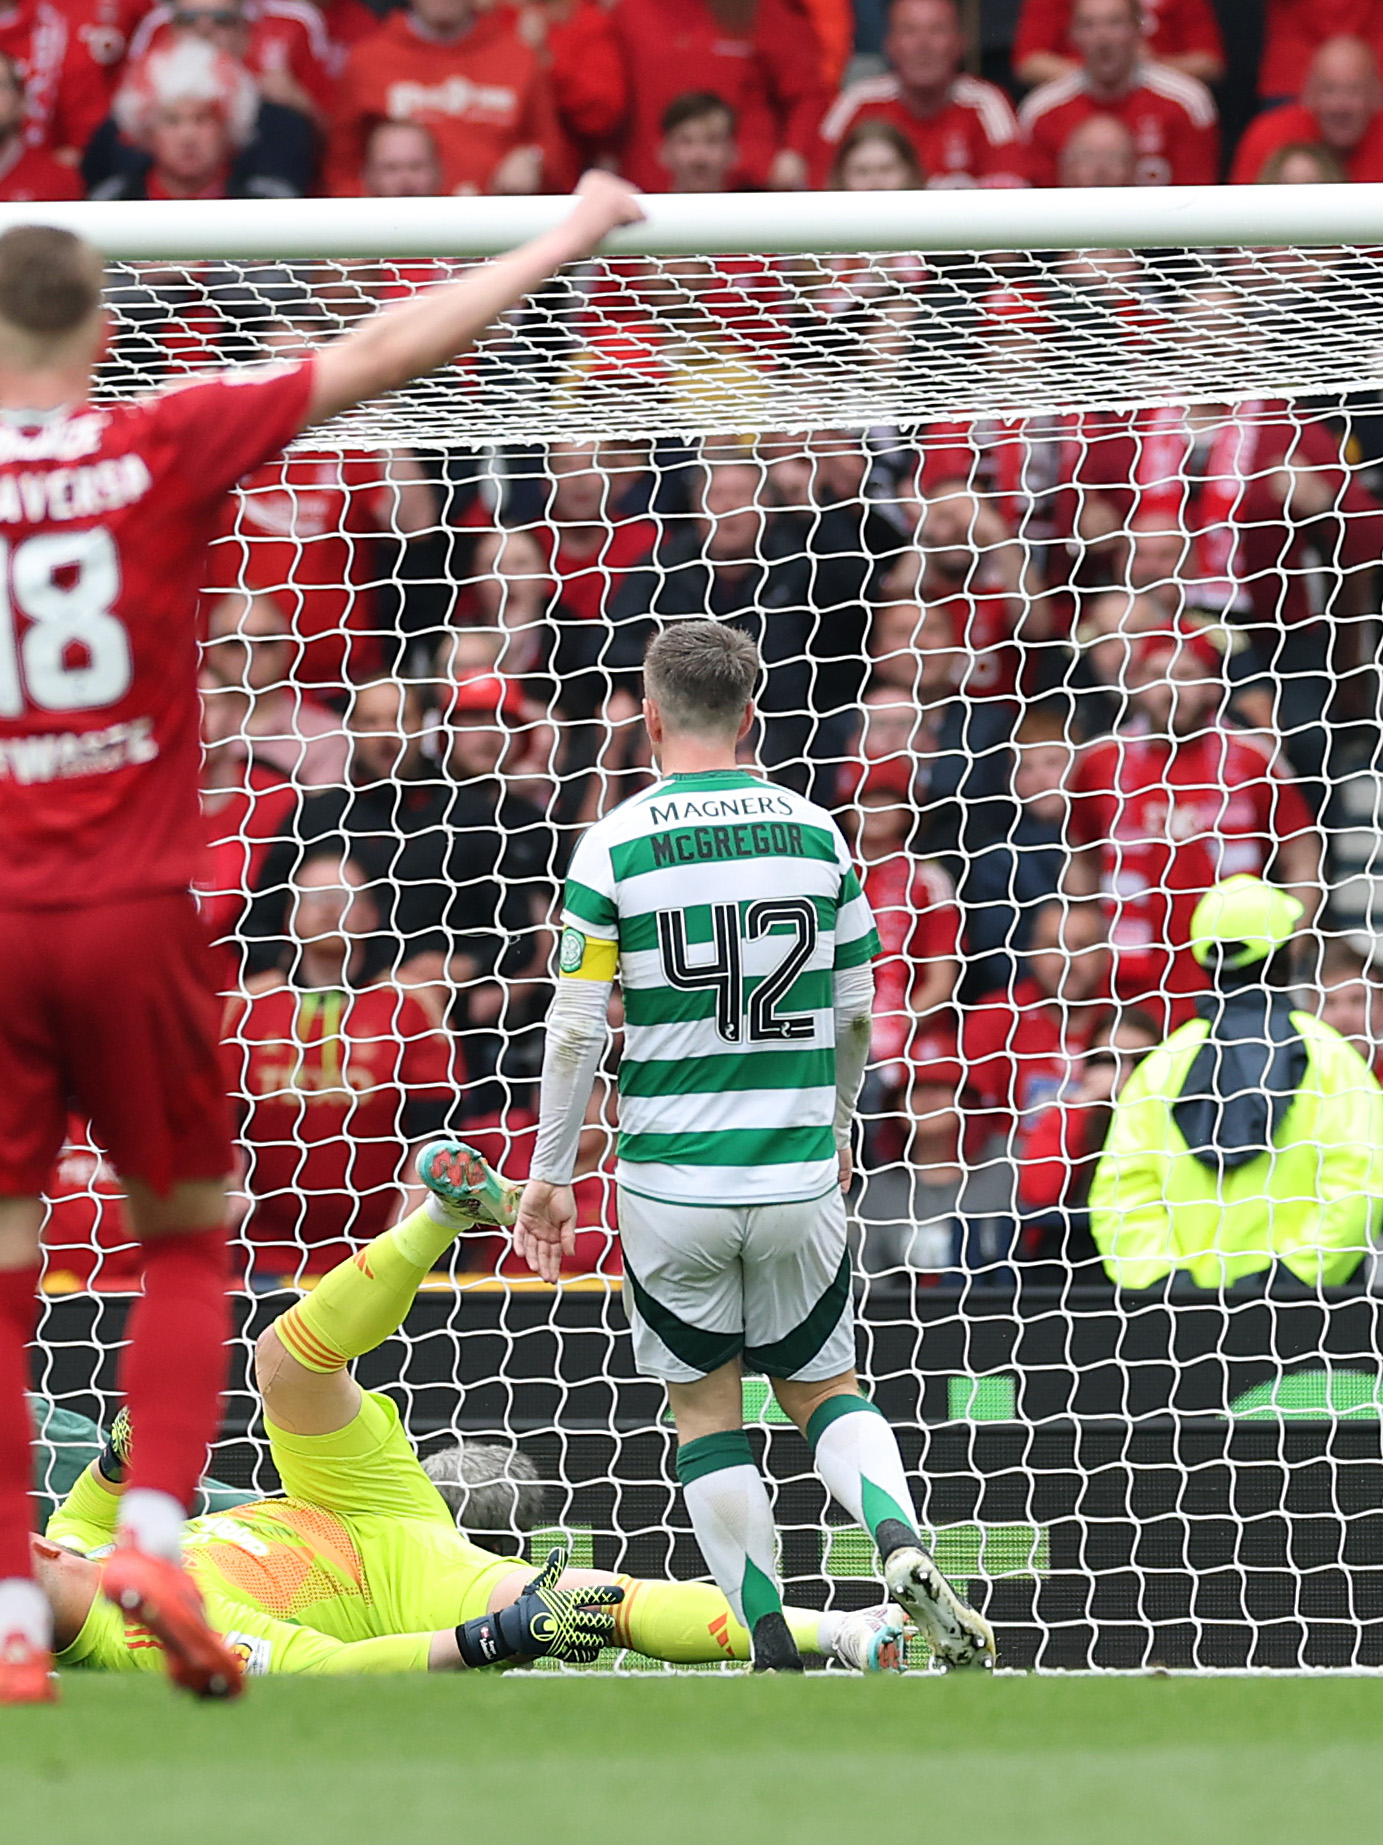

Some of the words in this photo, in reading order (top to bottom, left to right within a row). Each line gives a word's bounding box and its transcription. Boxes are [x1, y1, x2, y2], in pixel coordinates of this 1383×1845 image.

[649, 796, 794, 826] MAGNERS
[650, 822, 805, 867] McGREGOR
[655, 895, 818, 1045] 42
